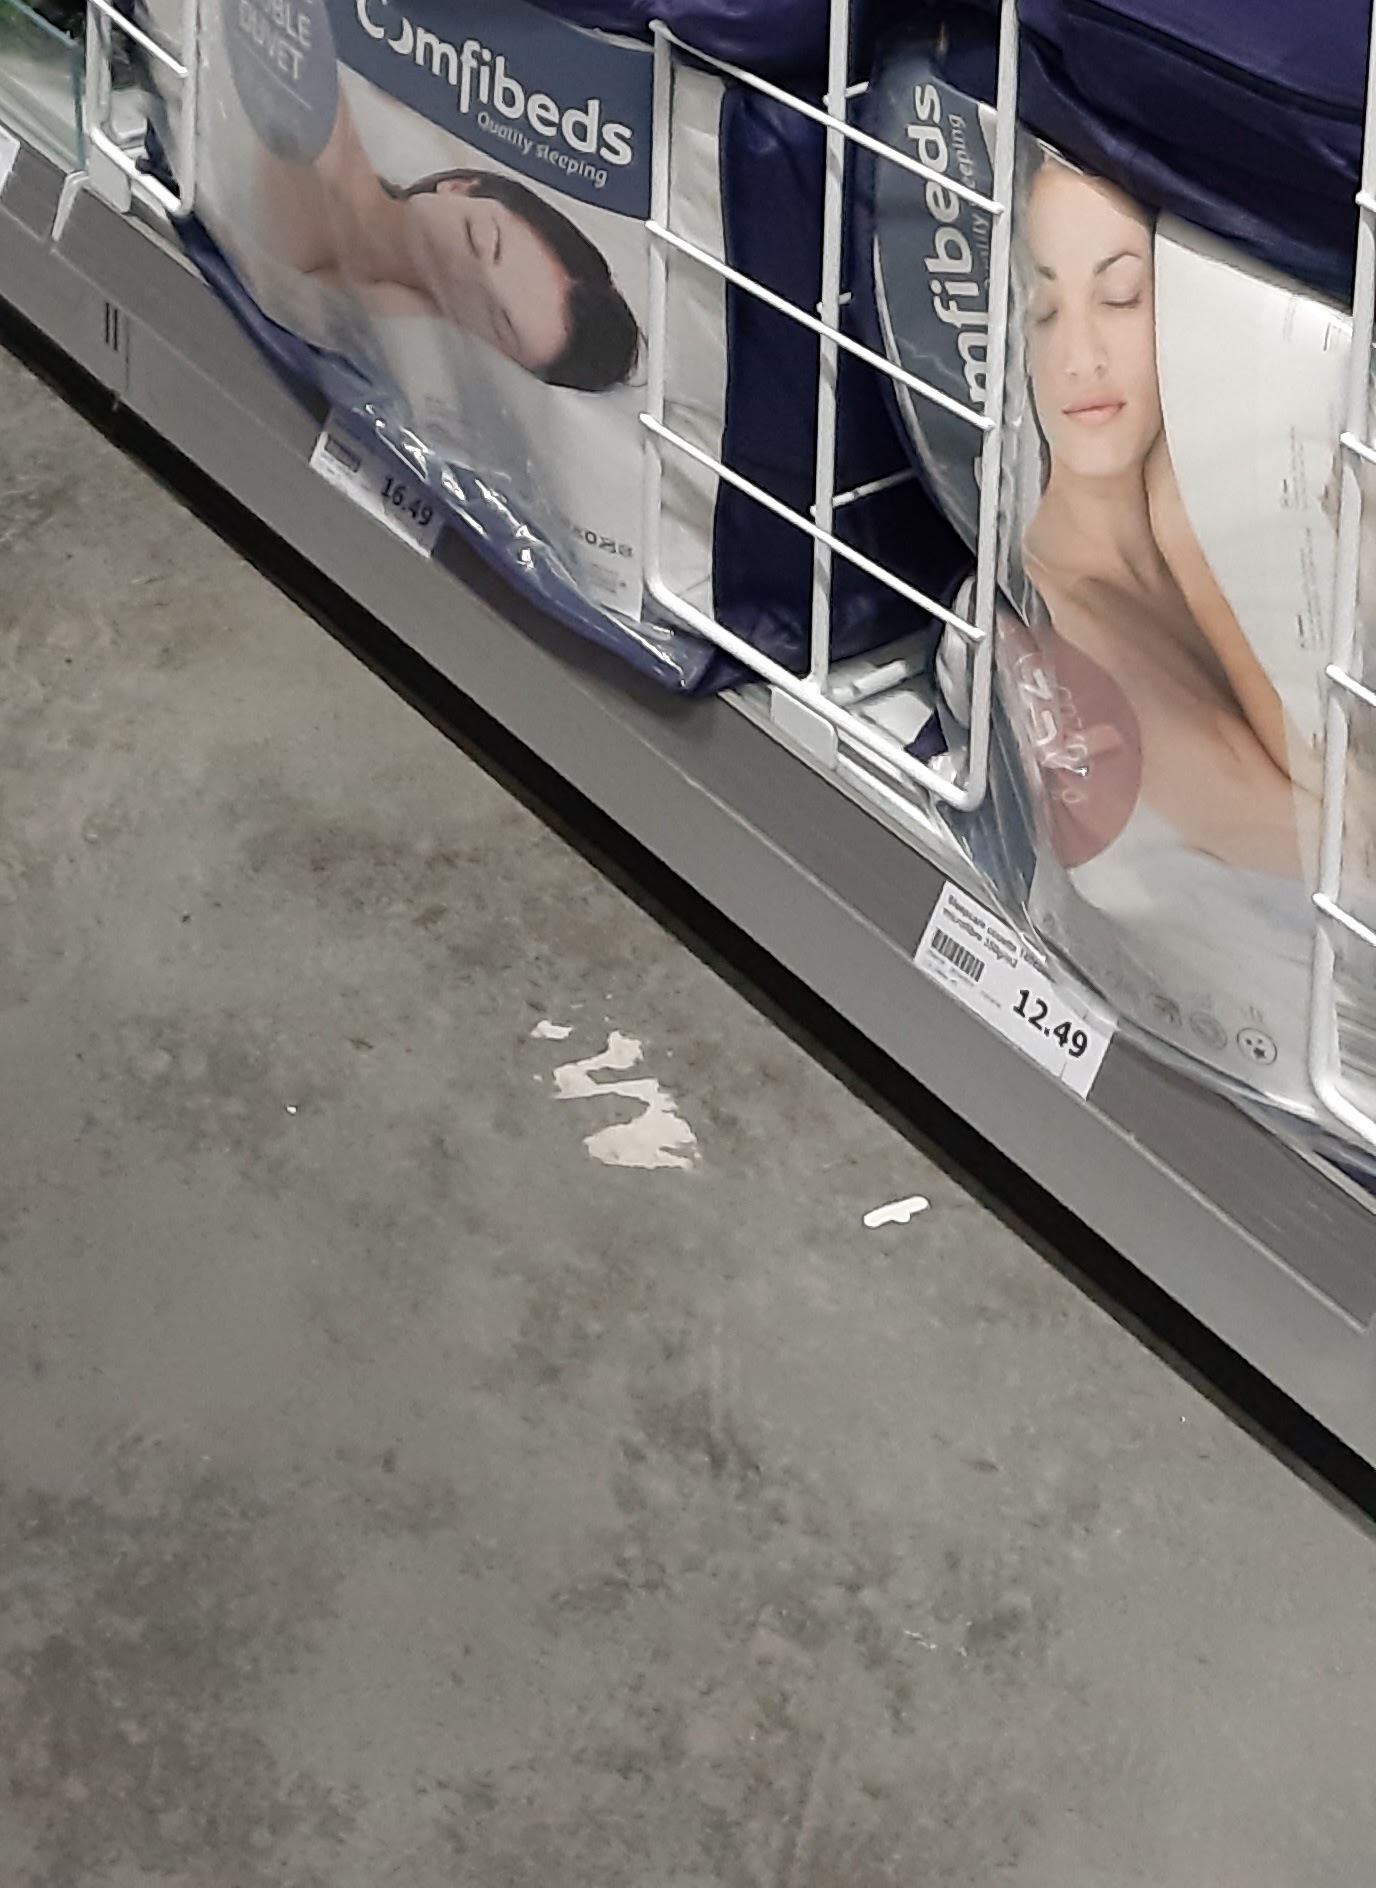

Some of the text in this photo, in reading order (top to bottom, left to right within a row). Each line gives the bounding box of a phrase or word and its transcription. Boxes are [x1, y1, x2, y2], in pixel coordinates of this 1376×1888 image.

[477, 110, 609, 190] Quality sleeping
[380, 475, 435, 527] 16.49
[1012, 987, 1089, 1058] 12.49
